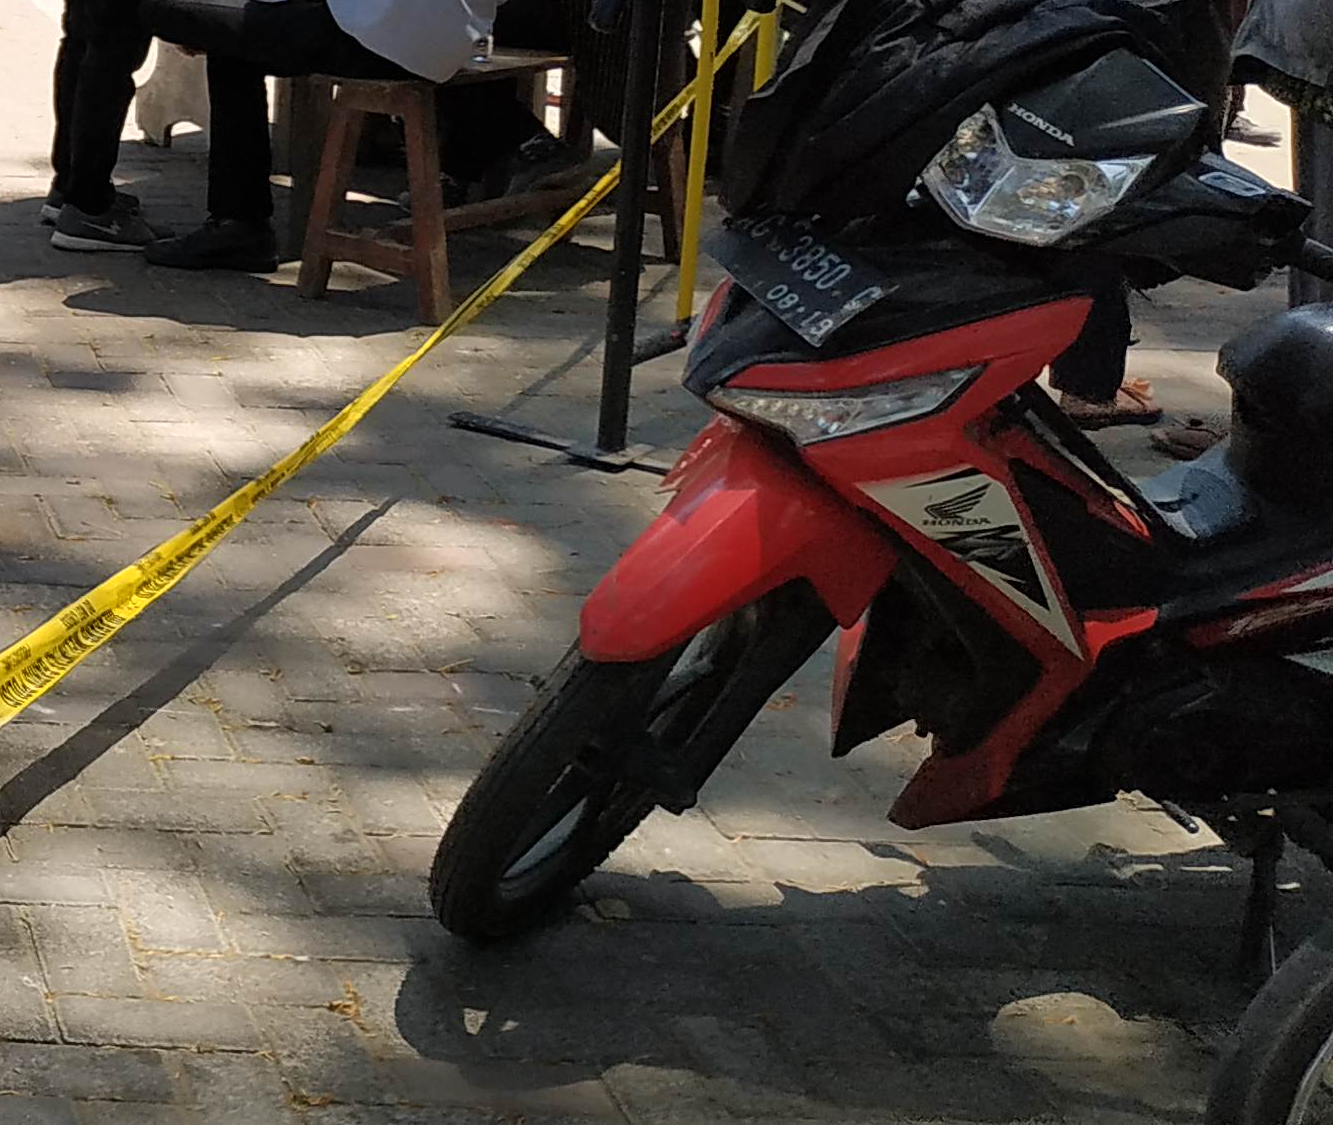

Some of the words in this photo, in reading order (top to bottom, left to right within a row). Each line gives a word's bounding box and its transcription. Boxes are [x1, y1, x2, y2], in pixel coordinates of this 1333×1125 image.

[1007, 102, 1075, 147] HONDA
[778, 235, 852, 291] 3850
[921, 516, 992, 527] HONDA
